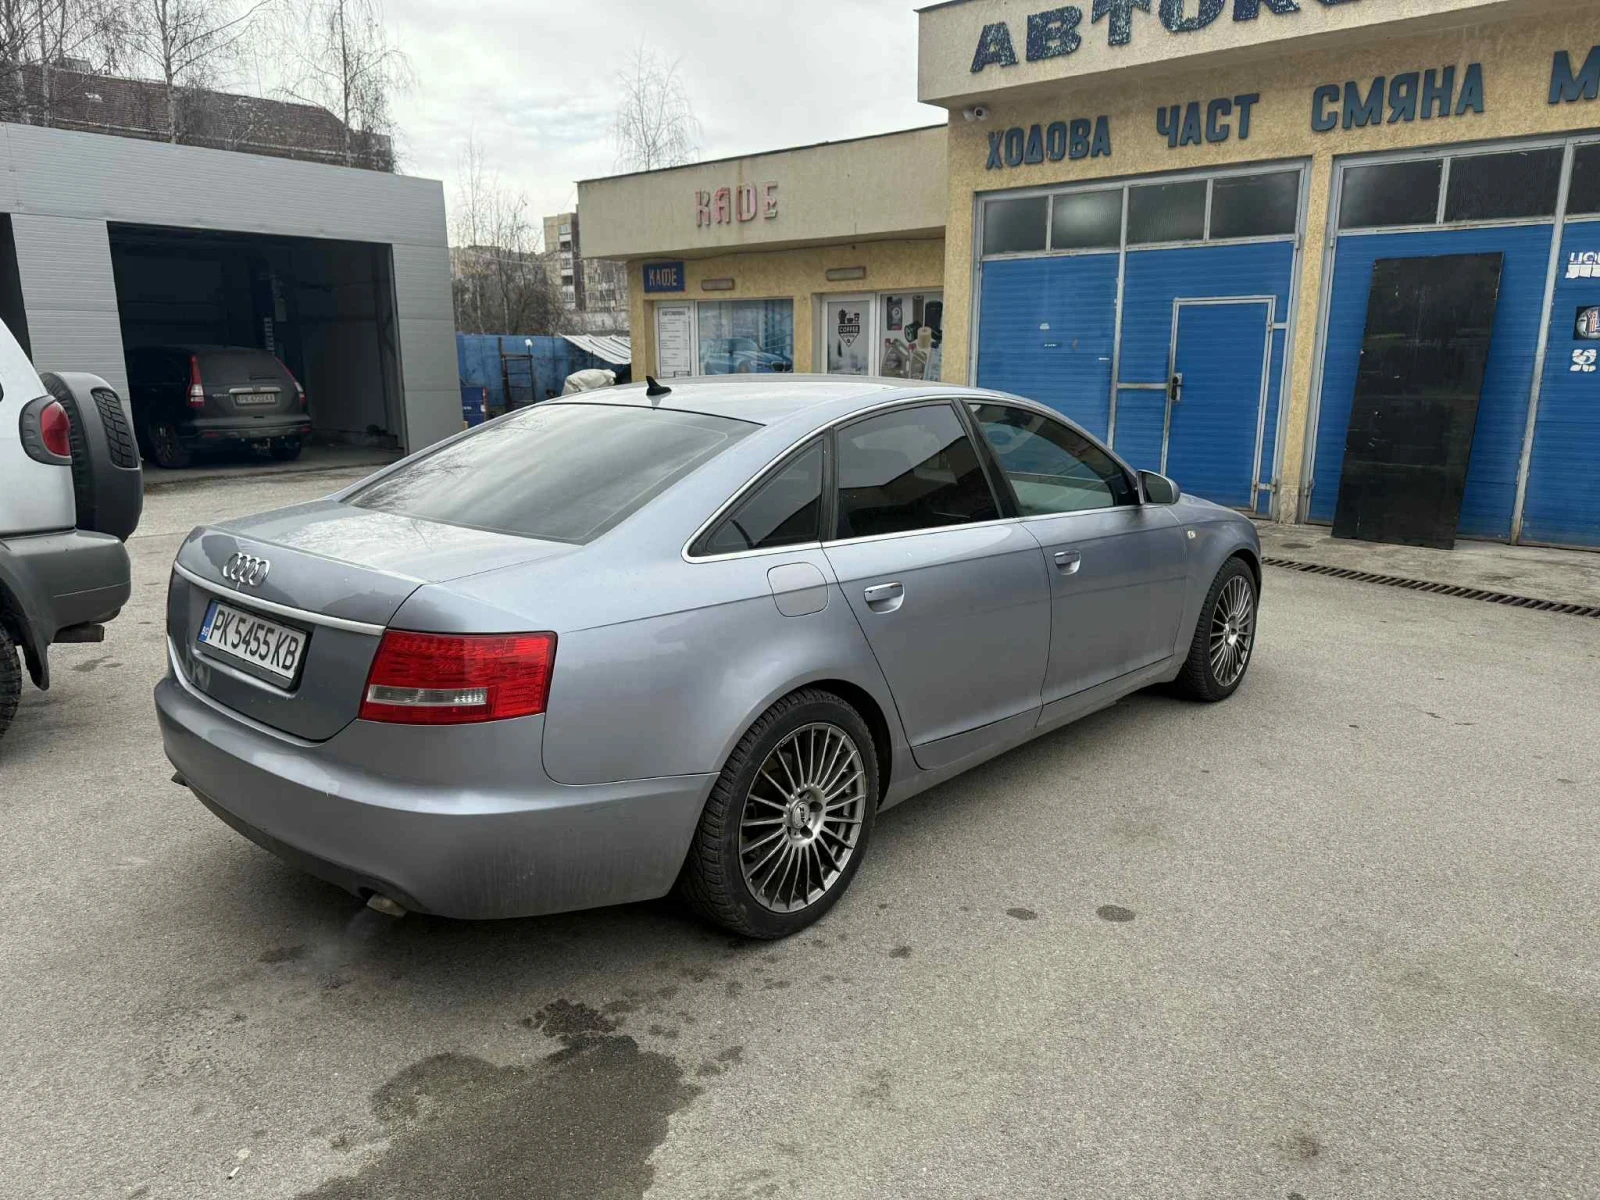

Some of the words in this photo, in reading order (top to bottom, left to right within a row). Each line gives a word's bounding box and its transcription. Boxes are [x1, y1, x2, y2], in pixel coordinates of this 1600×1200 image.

[986, 115, 1112, 170] ХОДОВА
[1156, 93, 1260, 148] ЧАСТ
[1311, 63, 1484, 132] СМЯНА
[694, 181, 778, 228] КАФЕ
[649, 267, 677, 287] КАФЕ
[231, 617, 275, 661] 5455
